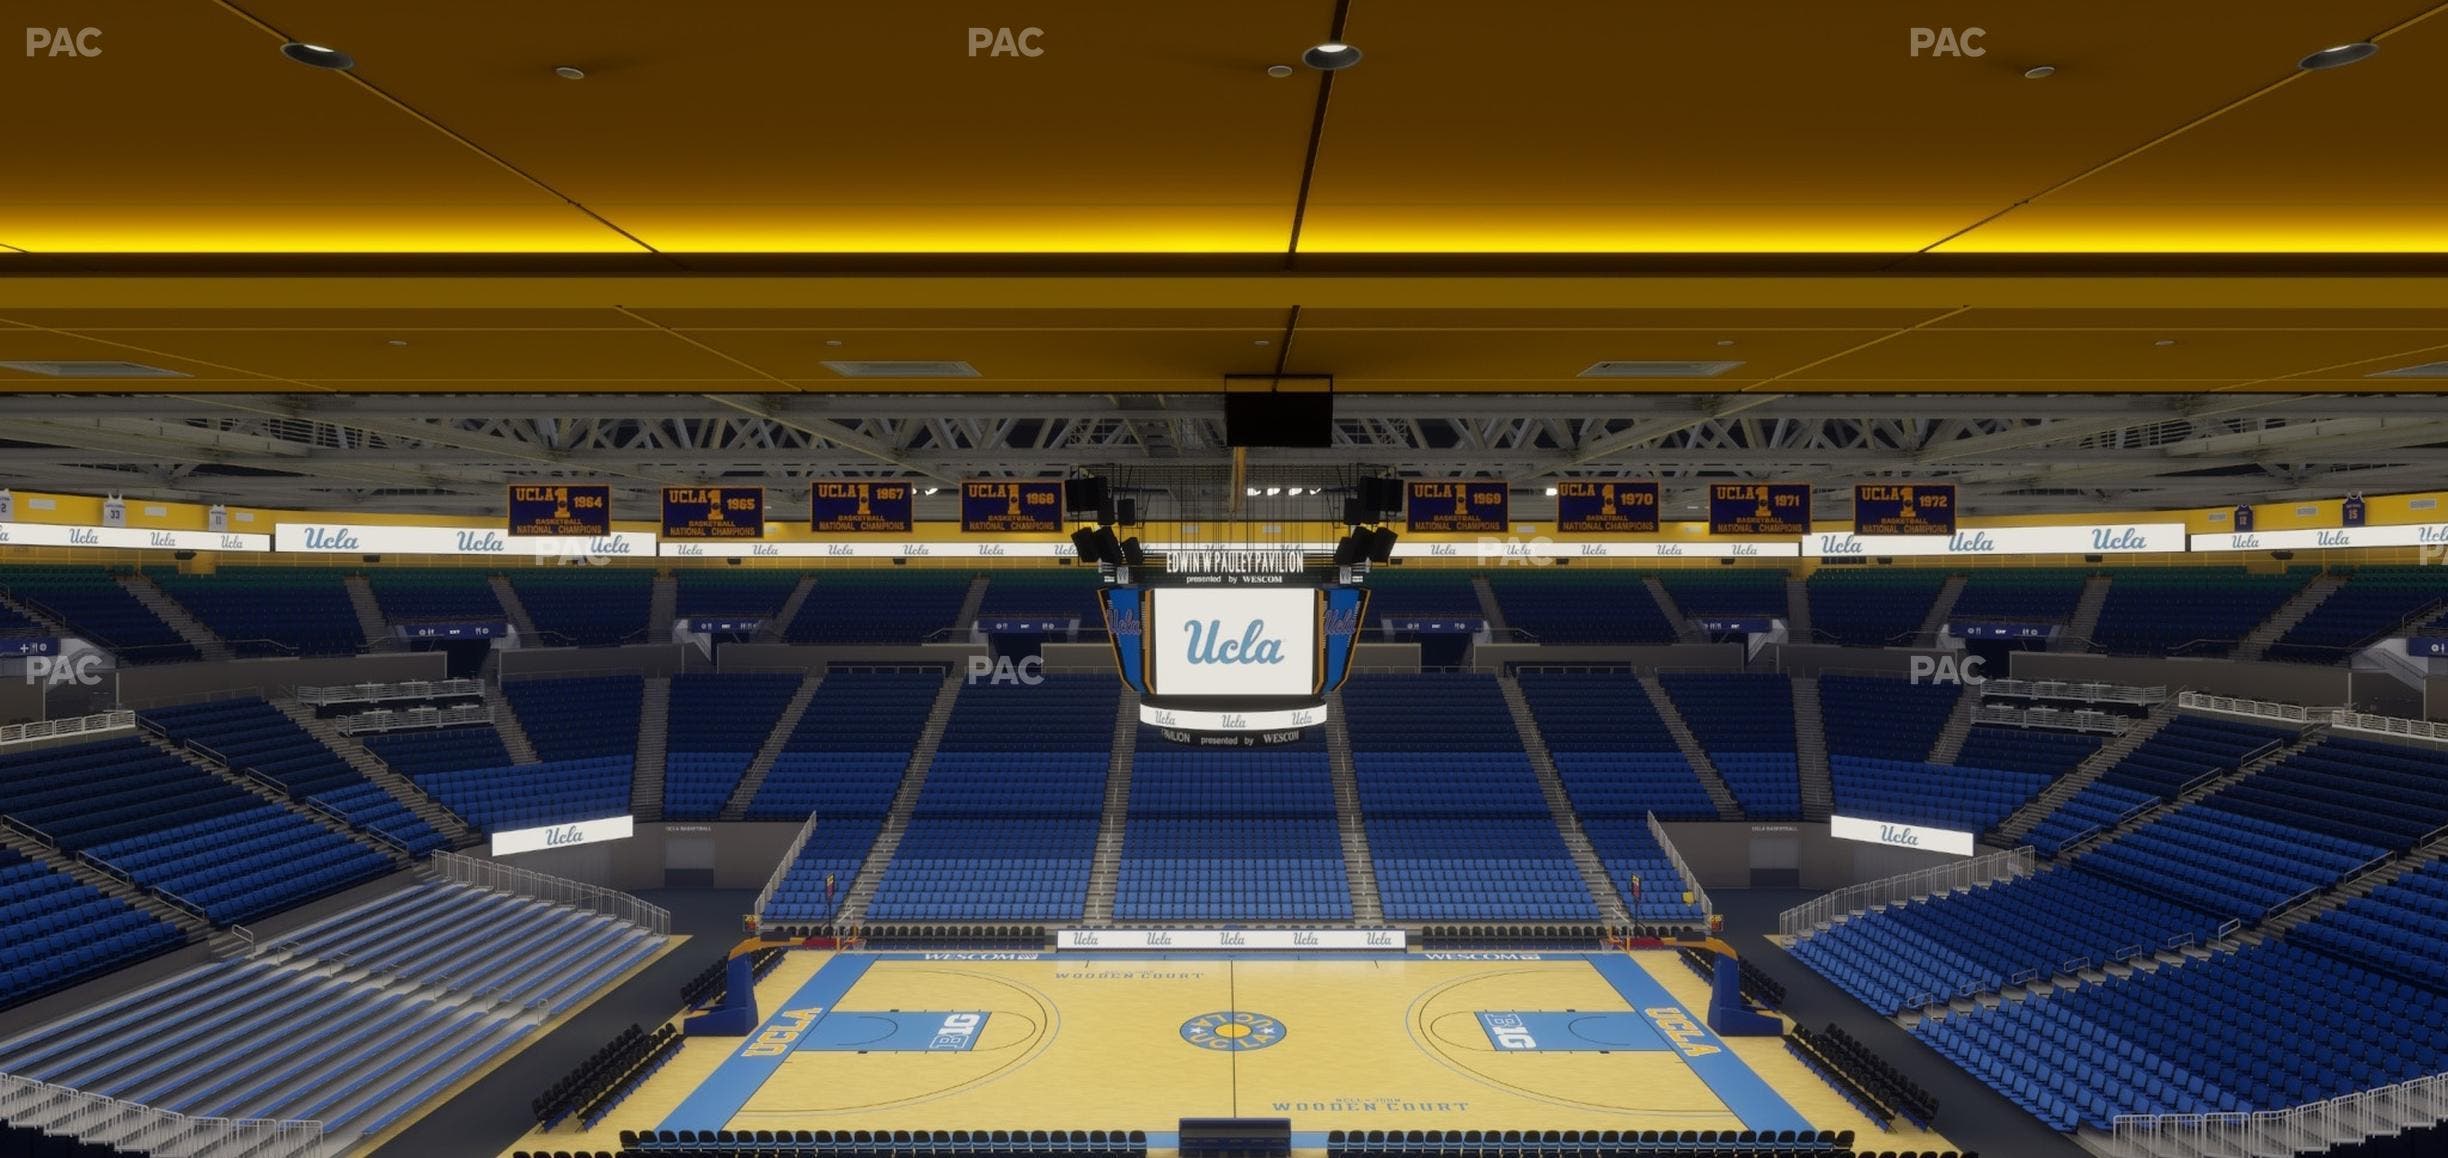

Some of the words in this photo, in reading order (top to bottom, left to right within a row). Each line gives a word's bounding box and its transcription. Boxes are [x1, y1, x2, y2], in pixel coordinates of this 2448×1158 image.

[516, 488, 554, 501] UCLA
[554, 488, 571, 518] 1
[574, 496, 602, 508] 1964
[669, 490, 707, 503] UCLA
[707, 490, 724, 520] 1
[727, 499, 755, 511] 1965
[818, 484, 857, 498] UCLA
[857, 484, 871, 515] 1
[876, 488, 904, 500] 1967
[968, 484, 1007, 498] UCLA
[1007, 484, 1021, 515] 1
[1026, 492, 1055, 505] 1968
[1414, 484, 1452, 498] UCLA
[1455, 484, 1468, 515] 1
[1473, 492, 1502, 505] 1969
[1560, 484, 1595, 497] UCLA
[1602, 484, 1616, 515] 1
[1621, 493, 1653, 506] 1970
[1717, 486, 1756, 500] UCLA
[1756, 486, 1771, 517] 1
[1774, 494, 1799, 507] 1971
[1861, 487, 1900, 500] UCLA
[1900, 487, 1916, 517] 1
[1919, 495, 1948, 508] 1972
[517, 525, 552, 534] NATIONAL
[558, 525, 602, 534] CHAMPIONS
[670, 527, 706, 536] NATIONAL
[711, 527, 755, 536] CHAMPIONS
[819, 522, 855, 531] NATIONAL
[860, 522, 904, 531] CHAMPIONS
[969, 522, 1005, 531] NATIONAL
[1011, 522, 1055, 531] CHAMPIONS
[1415, 522, 1451, 531] NATIONAL
[1456, 522, 1500, 531] CHAMPIONS
[1563, 522, 1600, 531] NATIONAL
[1605, 522, 1654, 531] CHAMPIONS
[1718, 524, 1754, 533] NATIONAL
[1759, 524, 1802, 533] CHAMPIONS
[1862, 525, 1898, 533] NATIONAL
[1903, 525, 1948, 533] CHAMPIONS
[69, 528, 98, 544] Ucla
[150, 532, 176, 547] Ucla
[220, 535, 244, 549] Ucla
[304, 527, 359, 550] Ucla
[457, 531, 504, 552] Ucla
[590, 535, 631, 554] Ucla
[1821, 535, 1863, 554] Ucla
[1948, 531, 1994, 552] Ucla
[2092, 528, 2147, 550] Ucla
[2232, 535, 2259, 549] Ucla
[2316, 531, 2350, 546] Ucla
[2418, 526, 2448, 543] Ucl
[678, 544, 704, 556] Ucla
[753, 544, 779, 556] Ucla
[828, 544, 854, 556] Ucla
[904, 544, 930, 556] Ucla
[979, 544, 1005, 556] Ucla
[1430, 544, 1456, 556] Ucla
[1581, 544, 1607, 556] Ucla
[1656, 544, 1682, 556] Ucla
[1732, 544, 1757, 556] Ucla
[1167, 551, 1200, 573] EDWIN
[1203, 551, 1212, 573] W
[1215, 551, 1254, 573] PAULEY
[1255, 551, 1304, 573] PAVILION
[1186, 575, 1221, 584] presented
[1228, 575, 1237, 584] by
[1184, 619, 1285, 664] Ucla
[1155, 711, 1176, 726] Ucla
[1221, 715, 1248, 729] Ucla
[1291, 711, 1312, 725] Ucla
[1201, 735, 1238, 746] presented
[1244, 735, 1254, 747] by
[1263, 730, 1299, 744] WESCOM
[545, 825, 584, 846] Ucla
[1880, 824, 1919, 846] Ucla
[1073, 932, 1098, 946] Ucla
[1146, 932, 1171, 946] Ucla
[1220, 932, 1245, 946] Ucla
[1293, 932, 1318, 946] Ucla
[1366, 932, 1391, 946] Ucla
[924, 953, 1015, 961] WESCOM
[1424, 953, 1517, 961] WESCOM
[741, 1007, 822, 1057] UCLA
[1190, 1033, 1275, 1049] UCLA
[1645, 1007, 1721, 1057] UCLA
[1272, 1102, 1376, 1111] WOODEN
[1386, 1102, 1469, 1111] COURT
